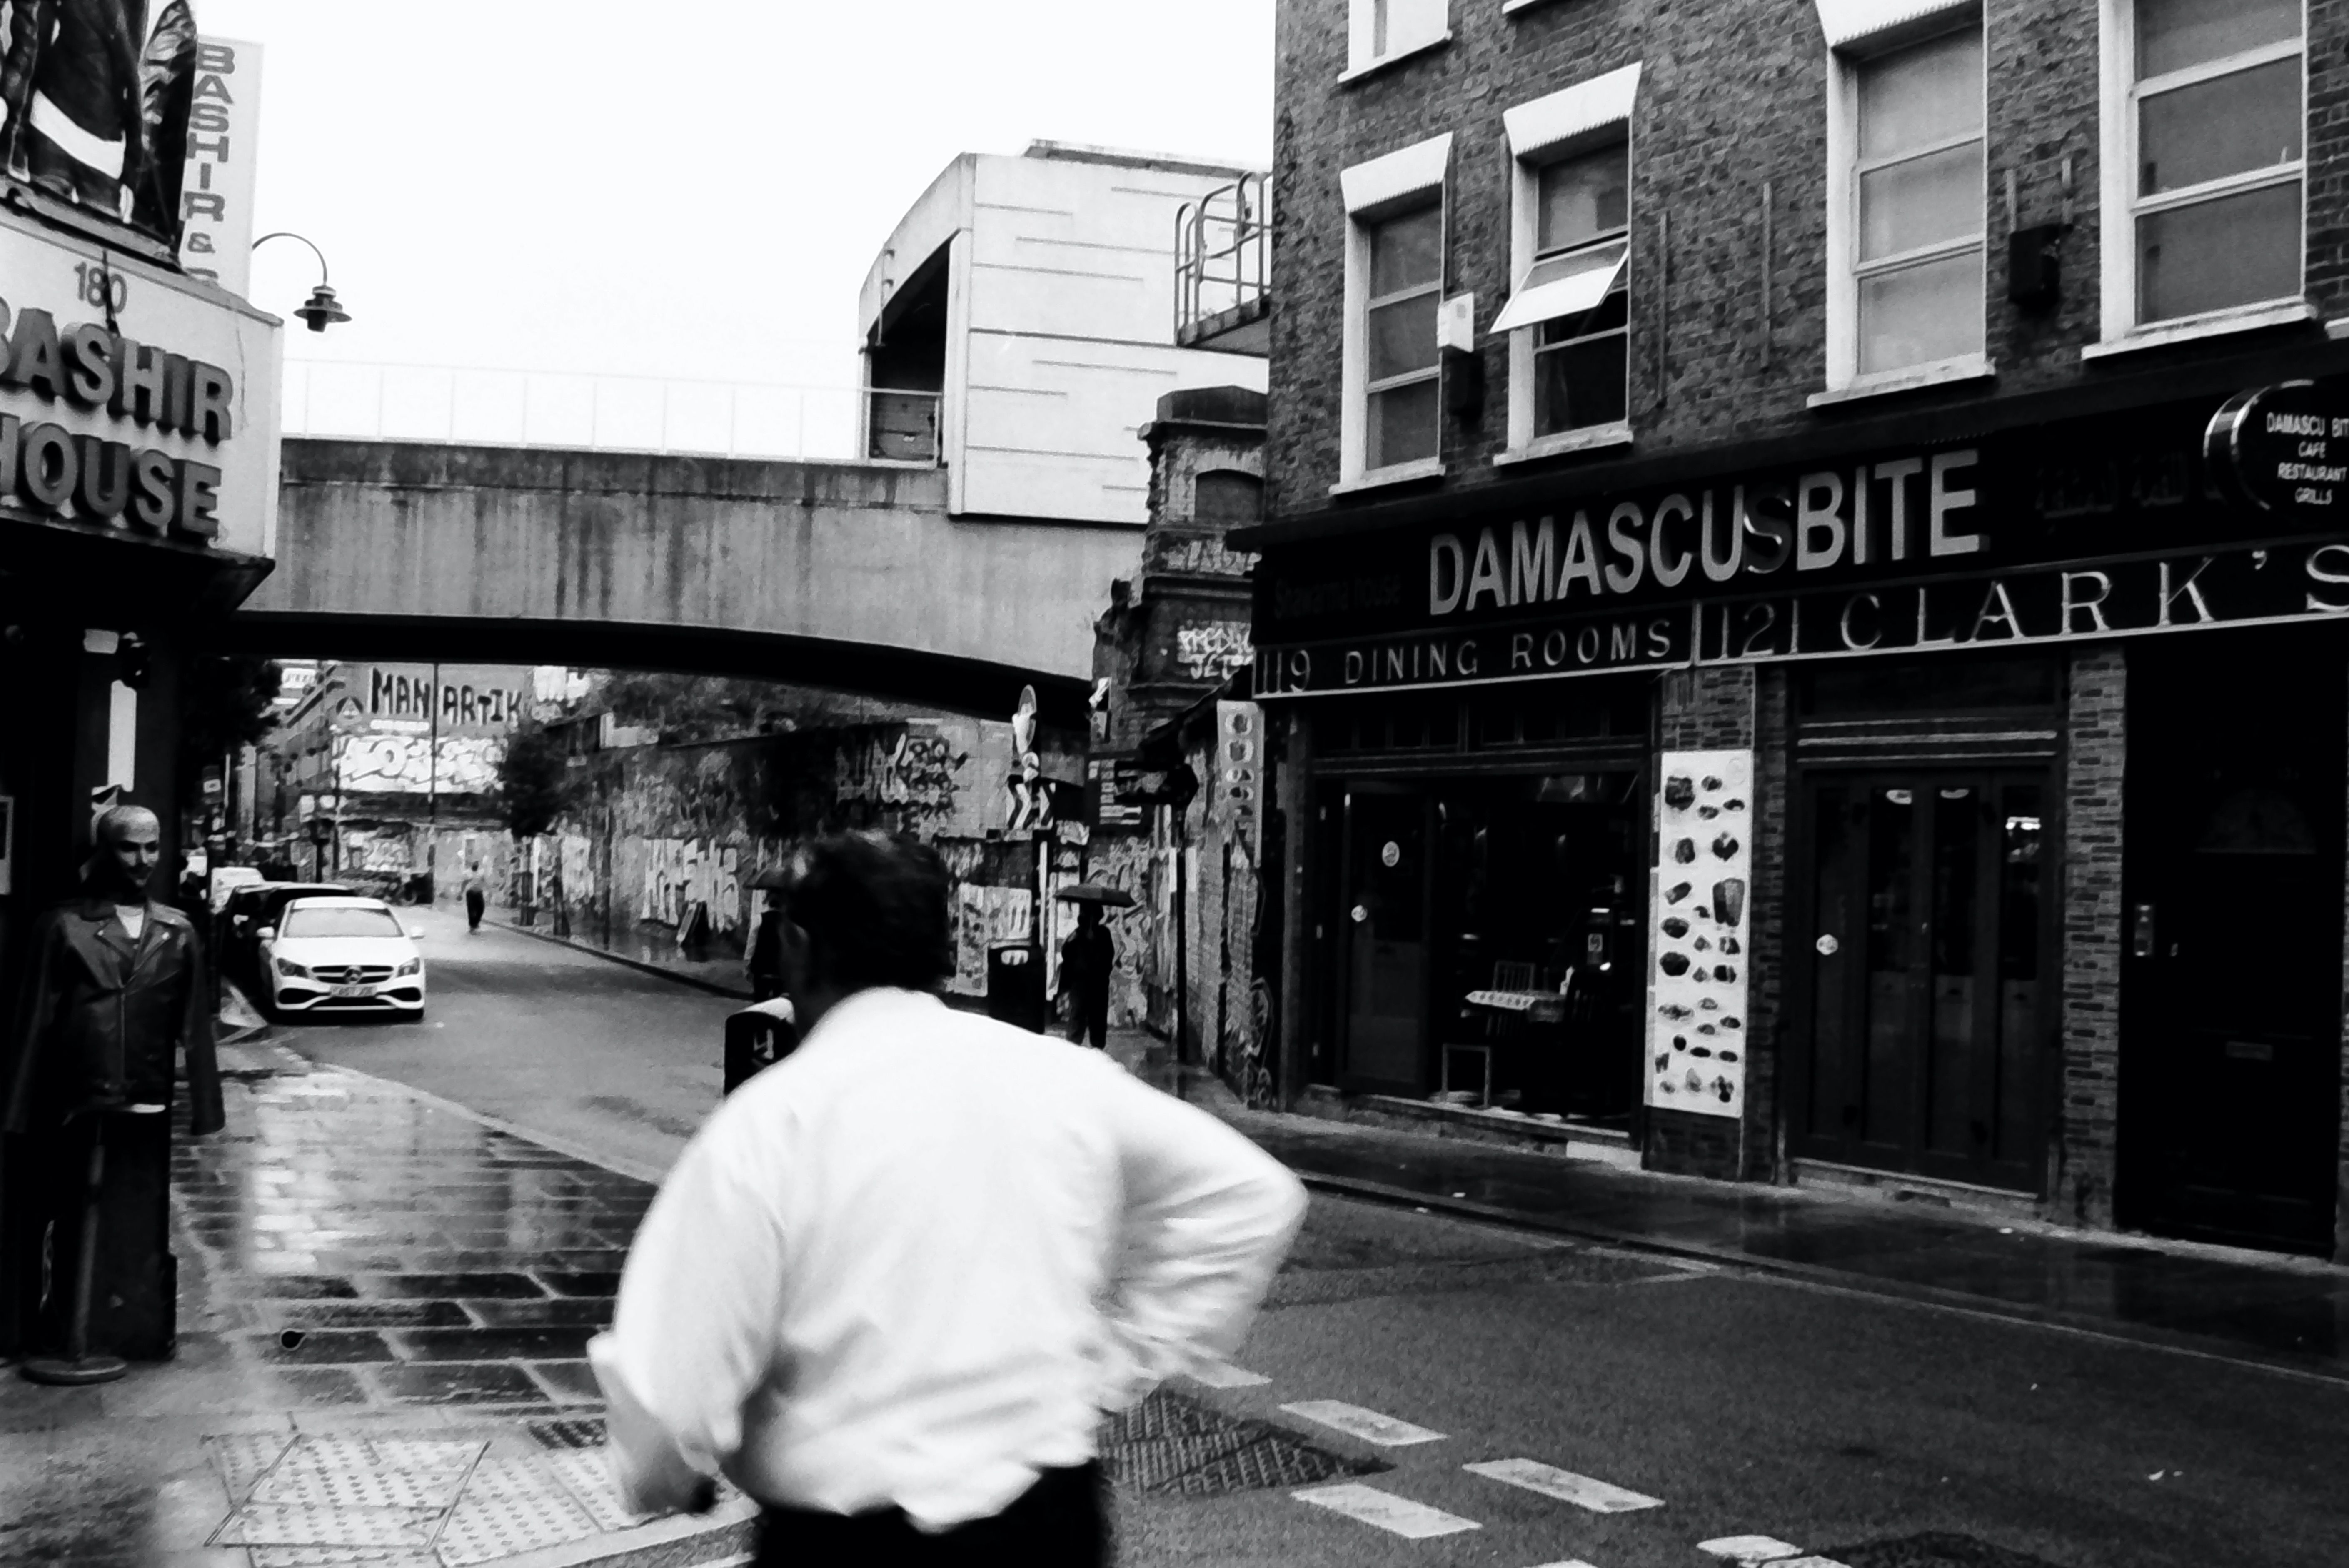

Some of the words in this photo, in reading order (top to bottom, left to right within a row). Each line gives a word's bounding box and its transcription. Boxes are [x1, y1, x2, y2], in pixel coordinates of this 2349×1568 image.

[185, 43, 235, 222] BASHIR
[74, 262, 127, 313] 180
[0, 297, 234, 442] ASHIR
[2277, 462, 2348, 482] RESTAURANT
[2298, 440, 2327, 459] CAFE
[1840, 544, 2349, 651] CLARK'S
[1263, 648, 1311, 694] 119
[1345, 639, 1478, 685] DINING
[1511, 619, 1670, 669] ROOMS
